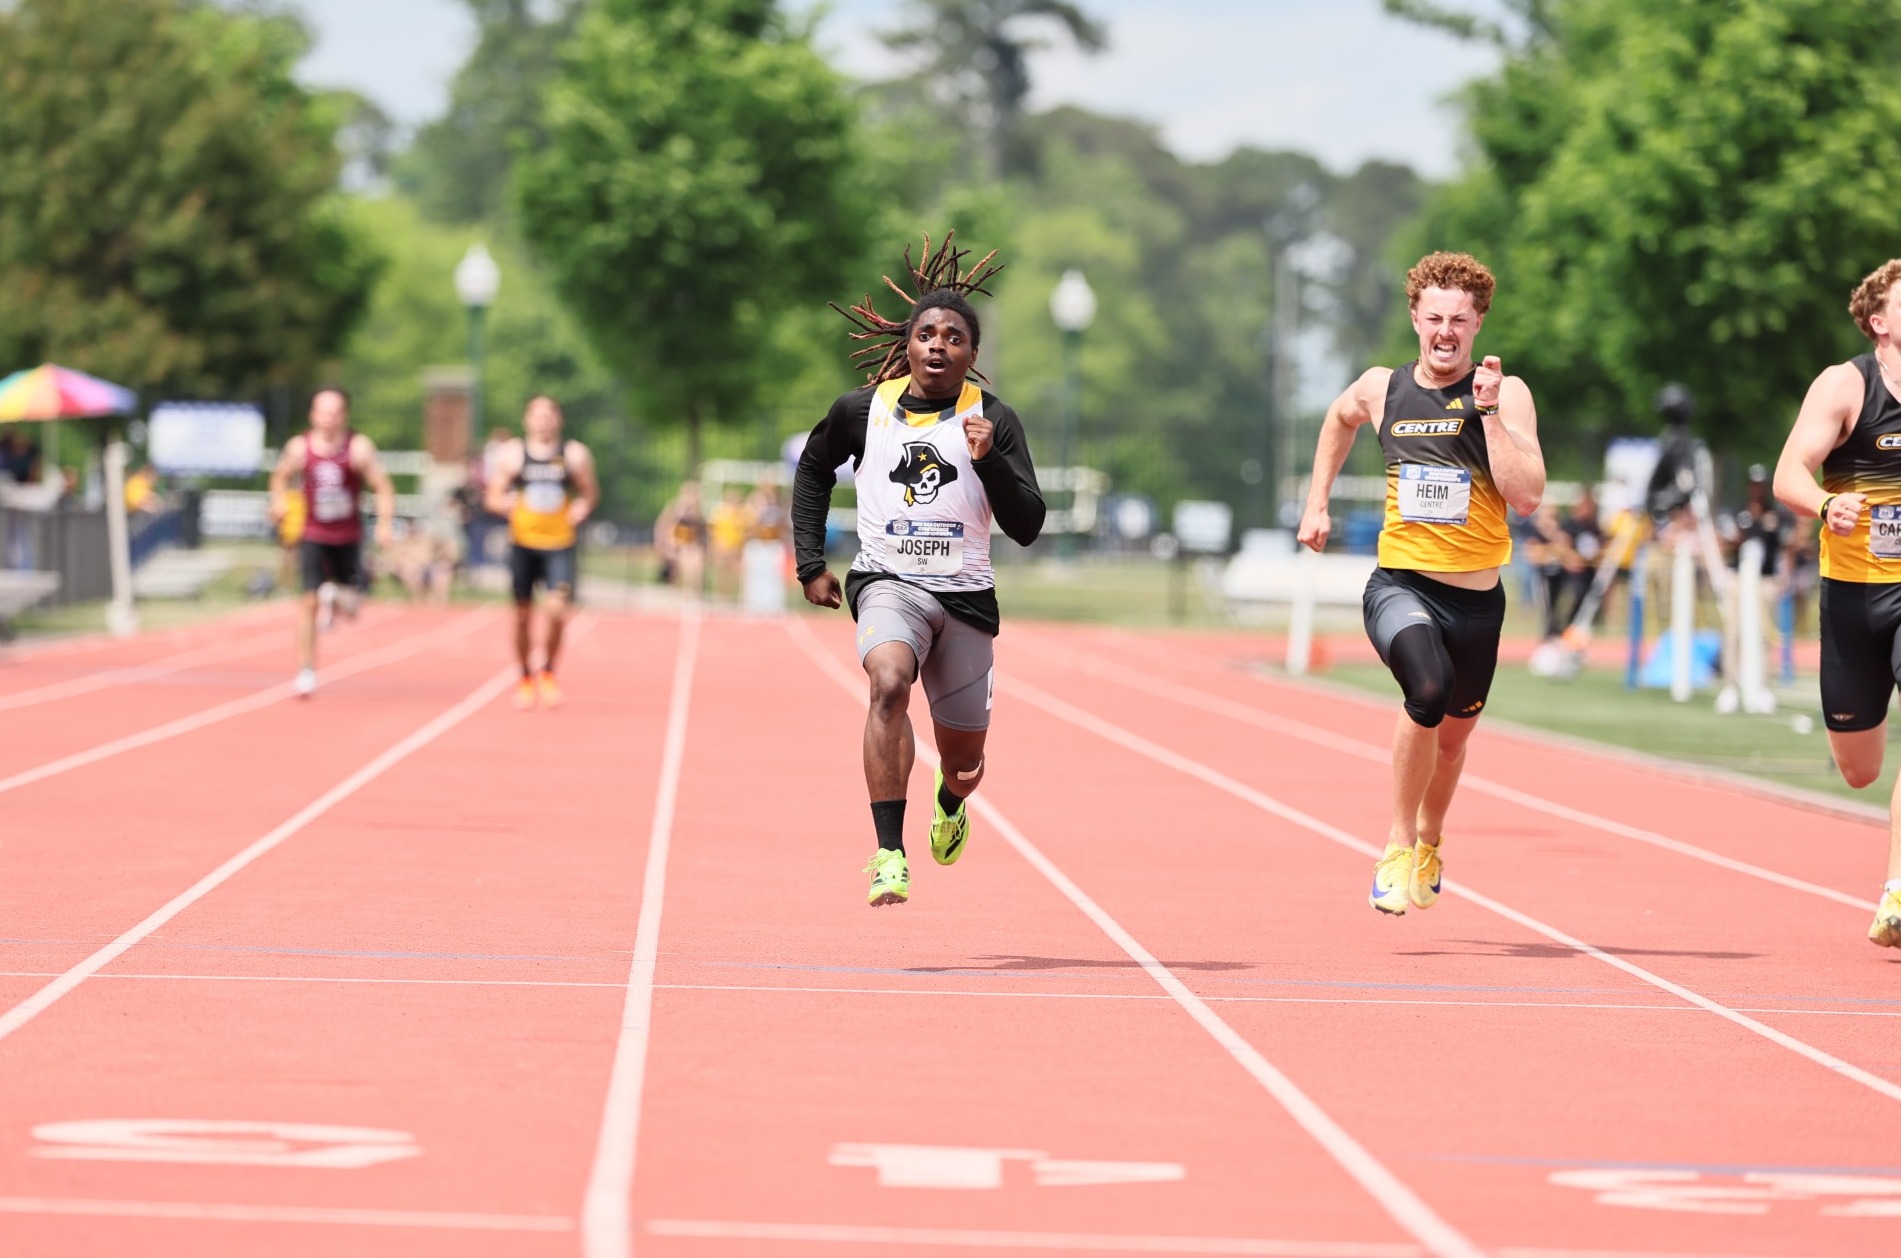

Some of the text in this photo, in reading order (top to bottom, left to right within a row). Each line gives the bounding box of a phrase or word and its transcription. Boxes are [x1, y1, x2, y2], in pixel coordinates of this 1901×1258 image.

[1393, 421, 1459, 434] CENTRE
[1416, 483, 1449, 500] HEIM
[897, 539, 950, 556] JOSEPH
[917, 557, 928, 566] SW
